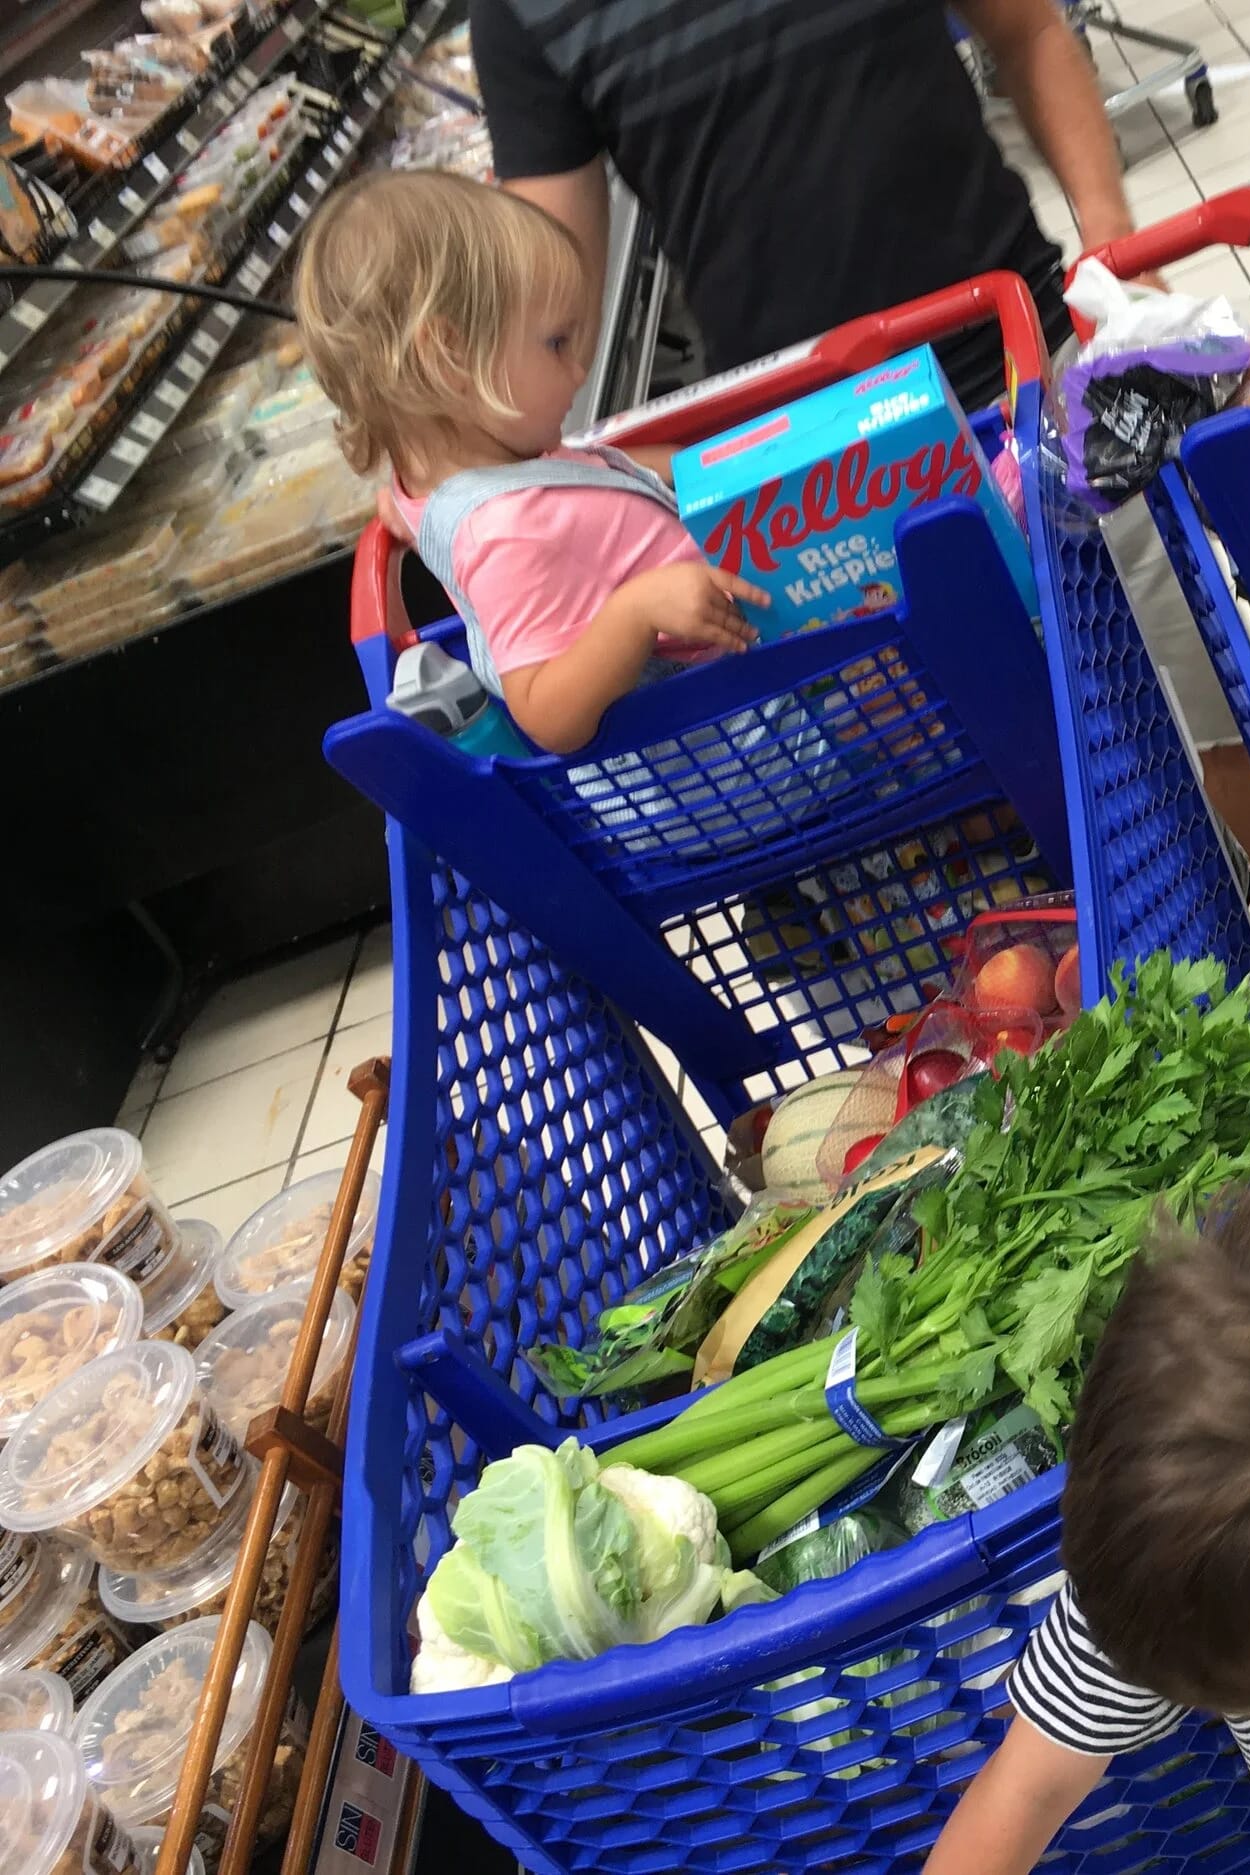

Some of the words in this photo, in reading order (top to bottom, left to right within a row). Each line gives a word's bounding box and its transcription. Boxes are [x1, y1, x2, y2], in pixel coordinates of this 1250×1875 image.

[784, 546, 897, 607] Krispie
[797, 534, 868, 574] Rice
[338, 1805, 362, 1852] SIN
